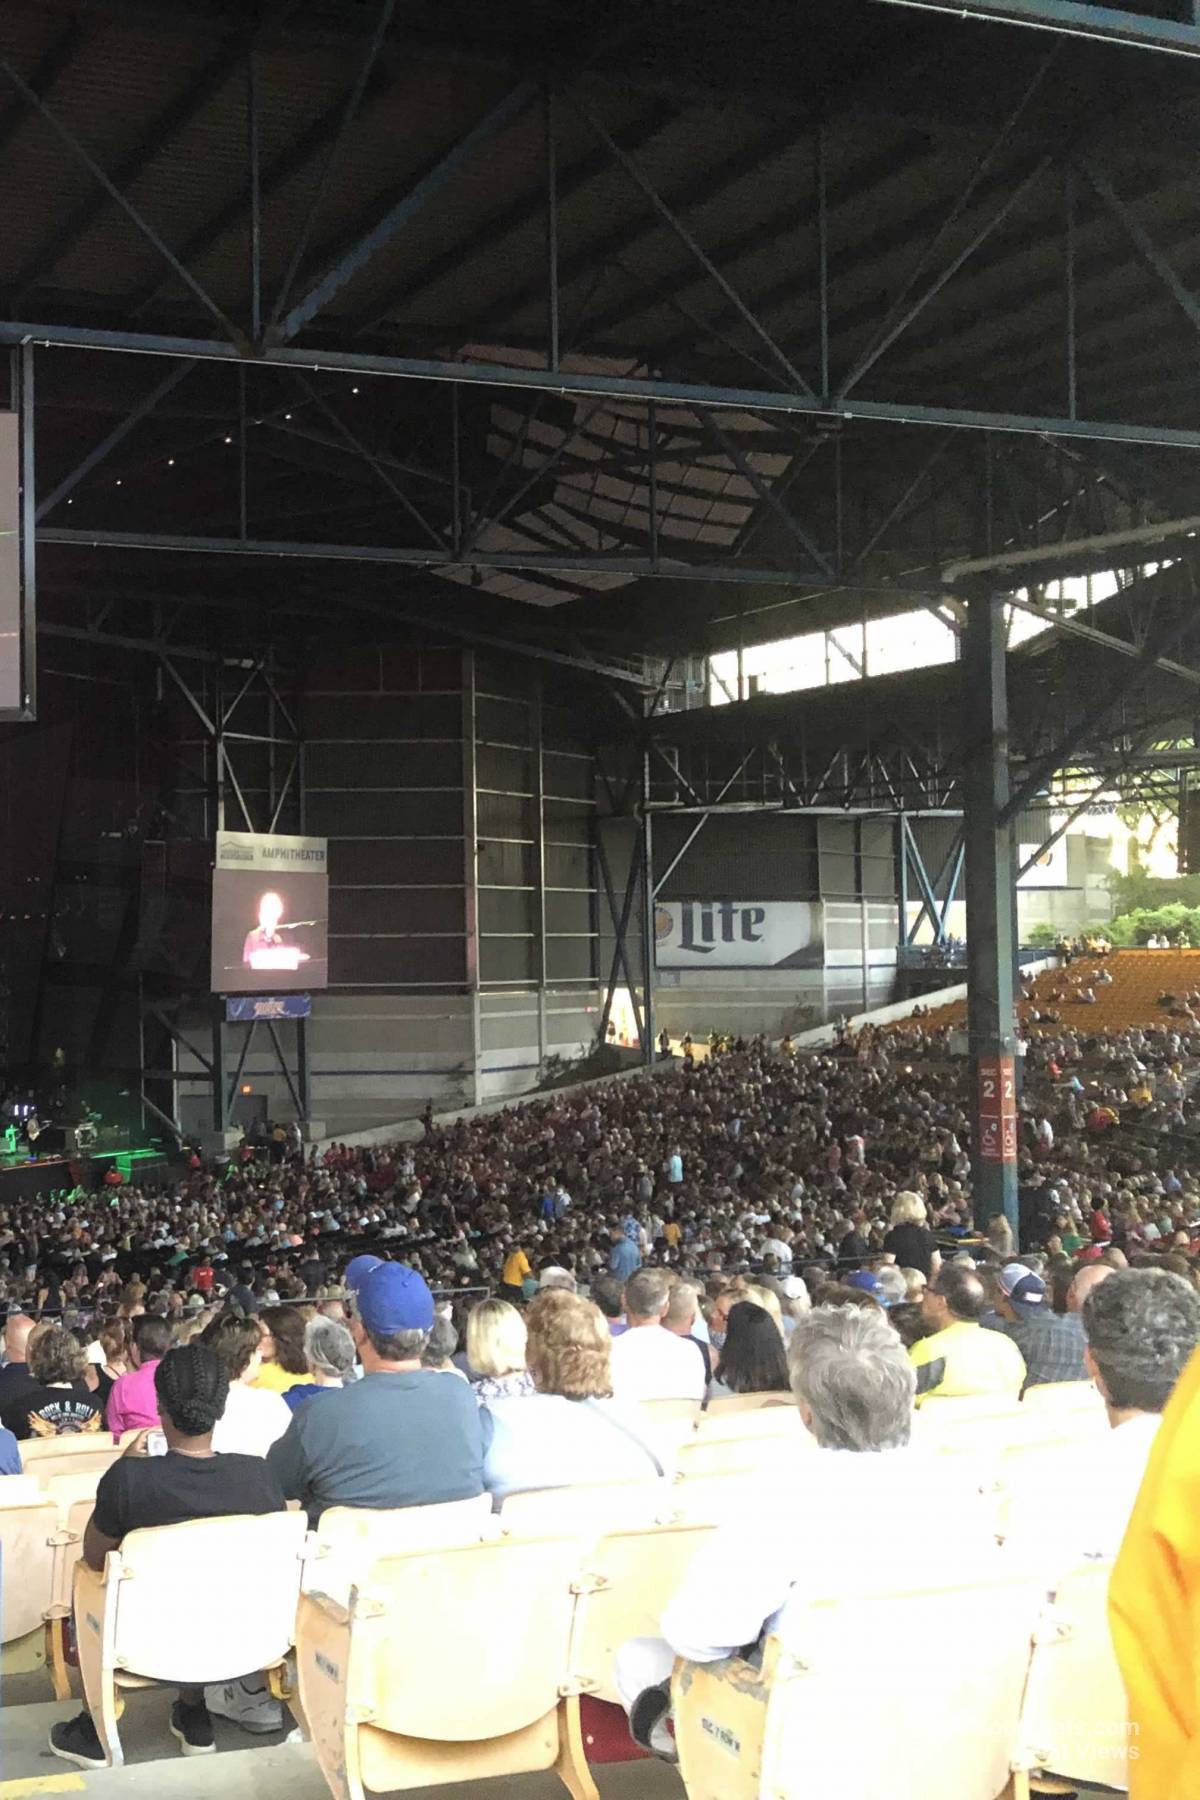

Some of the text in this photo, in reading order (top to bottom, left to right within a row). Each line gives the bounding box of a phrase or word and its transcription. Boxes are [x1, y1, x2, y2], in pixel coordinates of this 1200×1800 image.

[261, 847, 325, 862] AMPHITHEATER
[677, 901, 766, 954] Lite
[983, 1081, 995, 1098] 2
[1005, 1081, 1013, 1098] 2
[39, 1402, 61, 1419] ROCK
